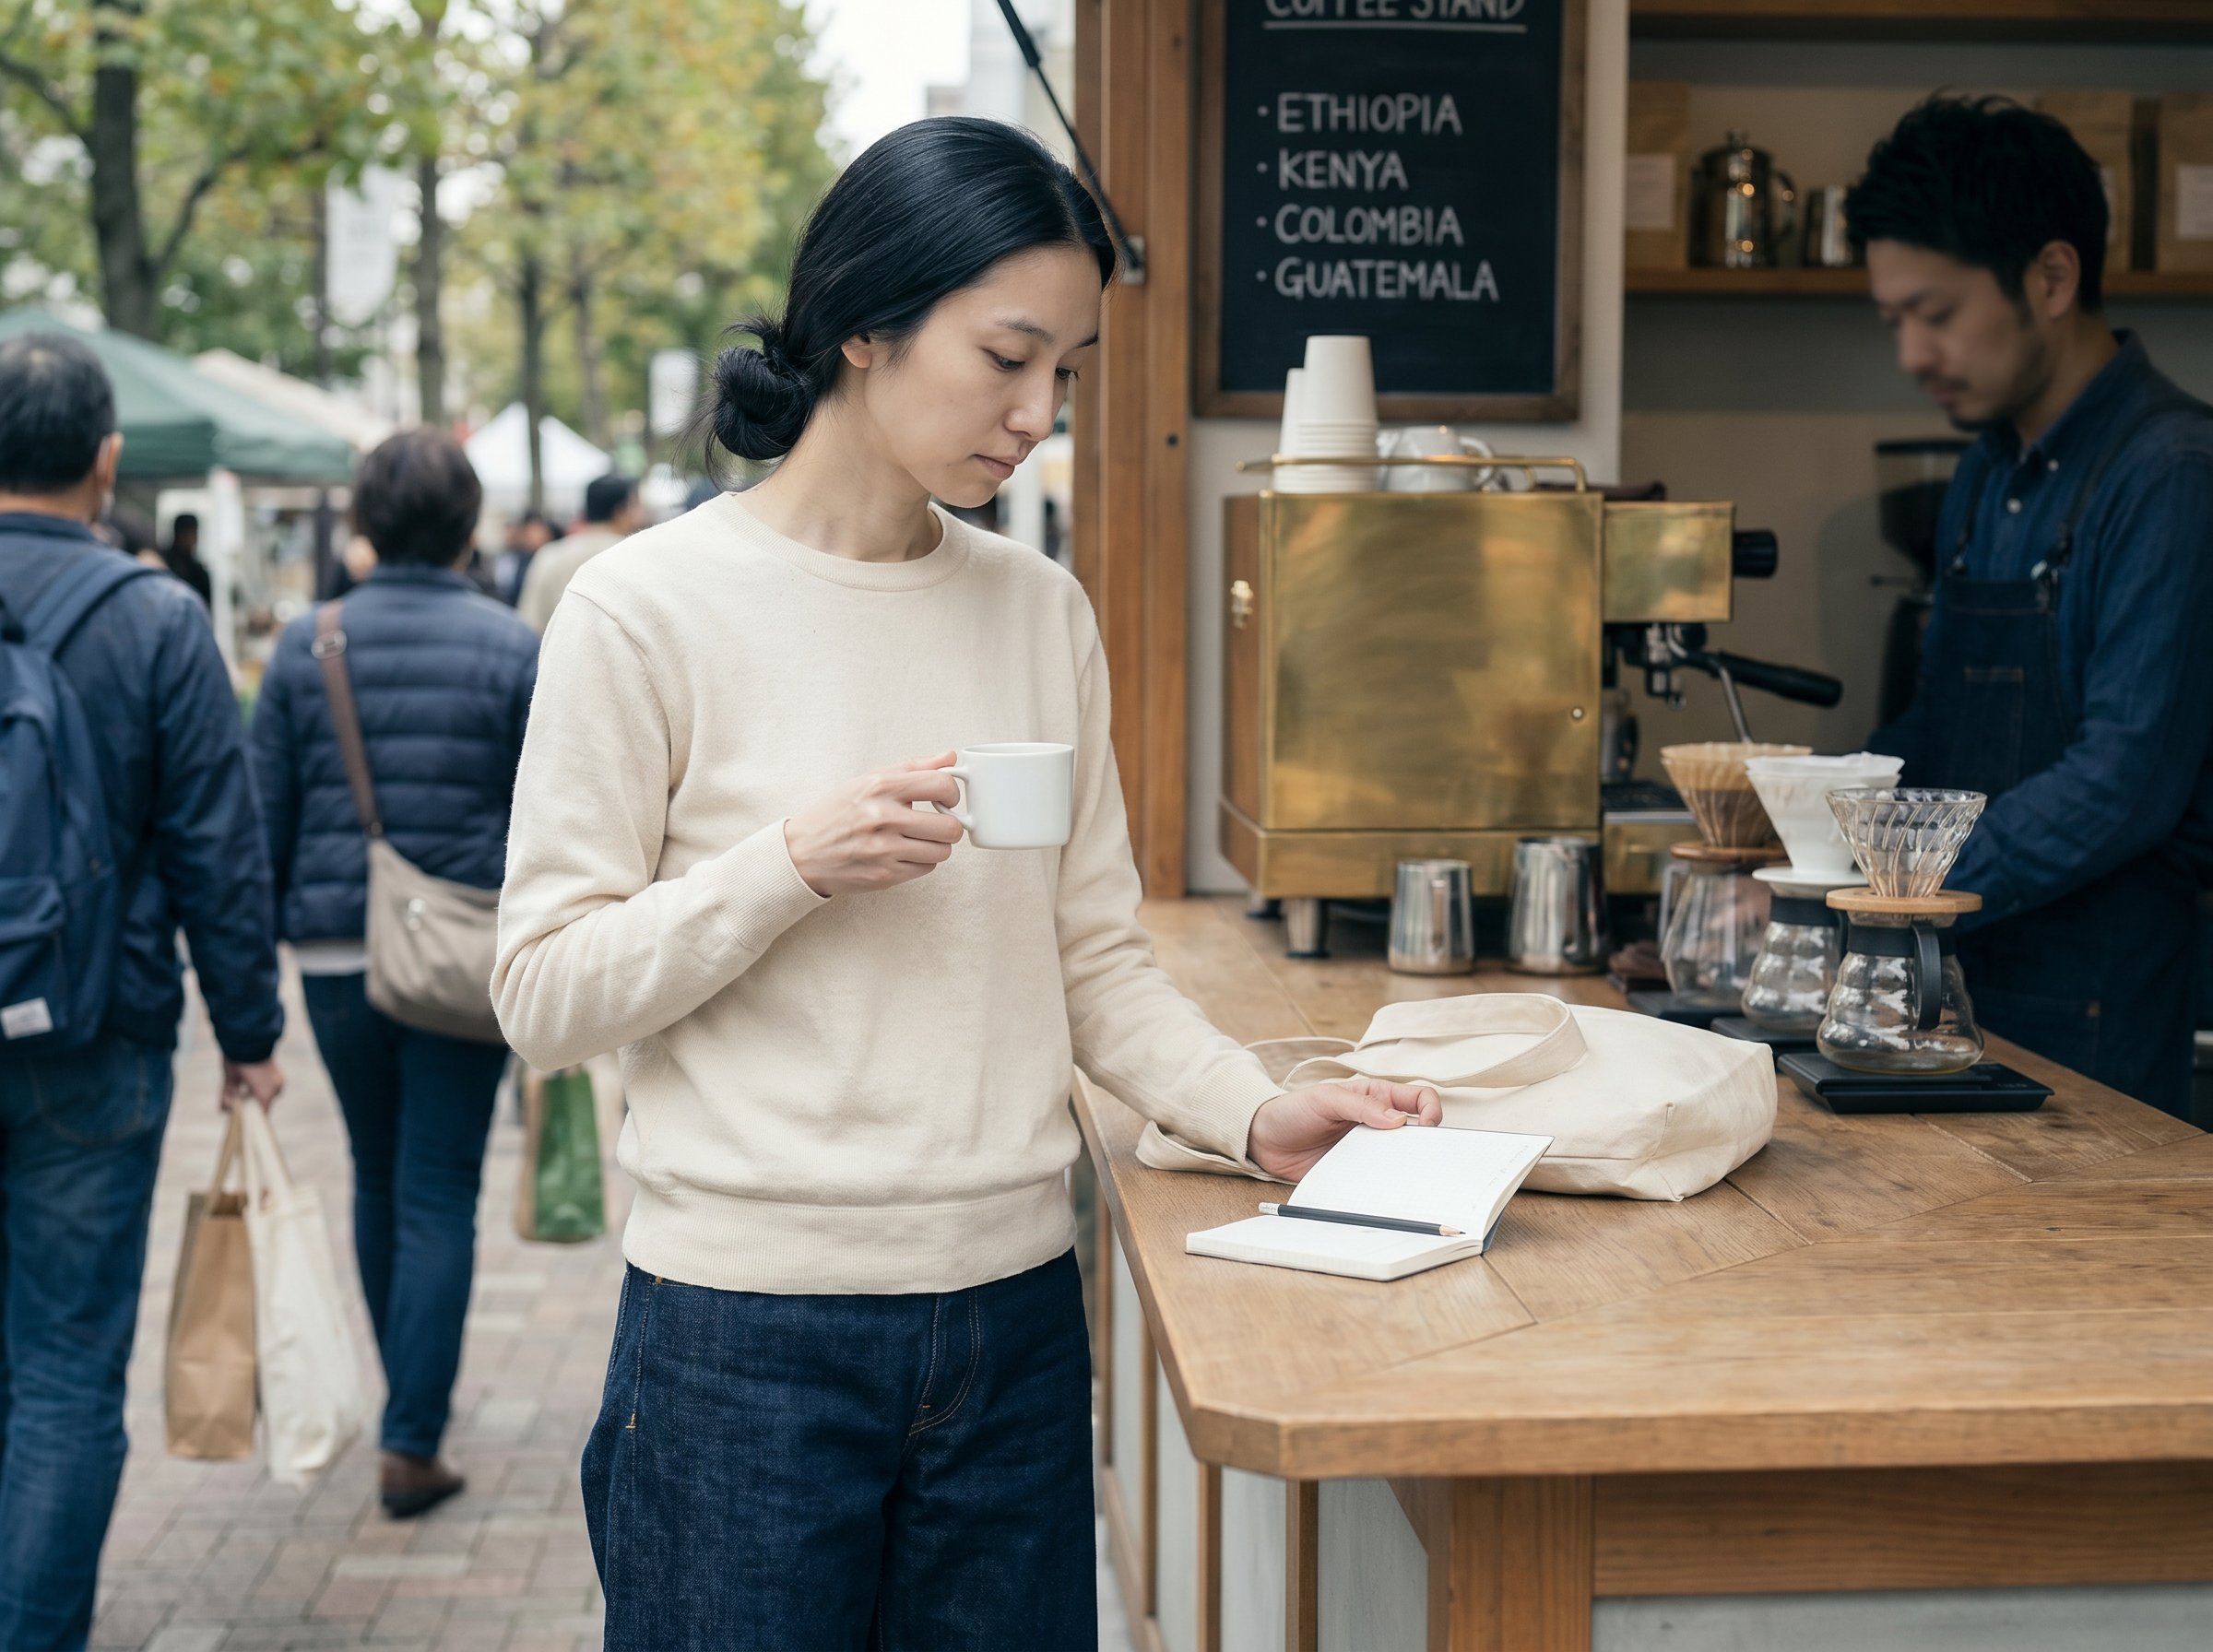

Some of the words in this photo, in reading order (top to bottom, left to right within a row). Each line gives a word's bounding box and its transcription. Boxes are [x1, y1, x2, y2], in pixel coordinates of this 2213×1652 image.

[1277, 92, 1462, 135] ETHIOPIA
[1278, 148, 1408, 191] KENYA
[1274, 203, 1464, 246] COLOMBIA
[1274, 256, 1499, 301] GUATEMALA
